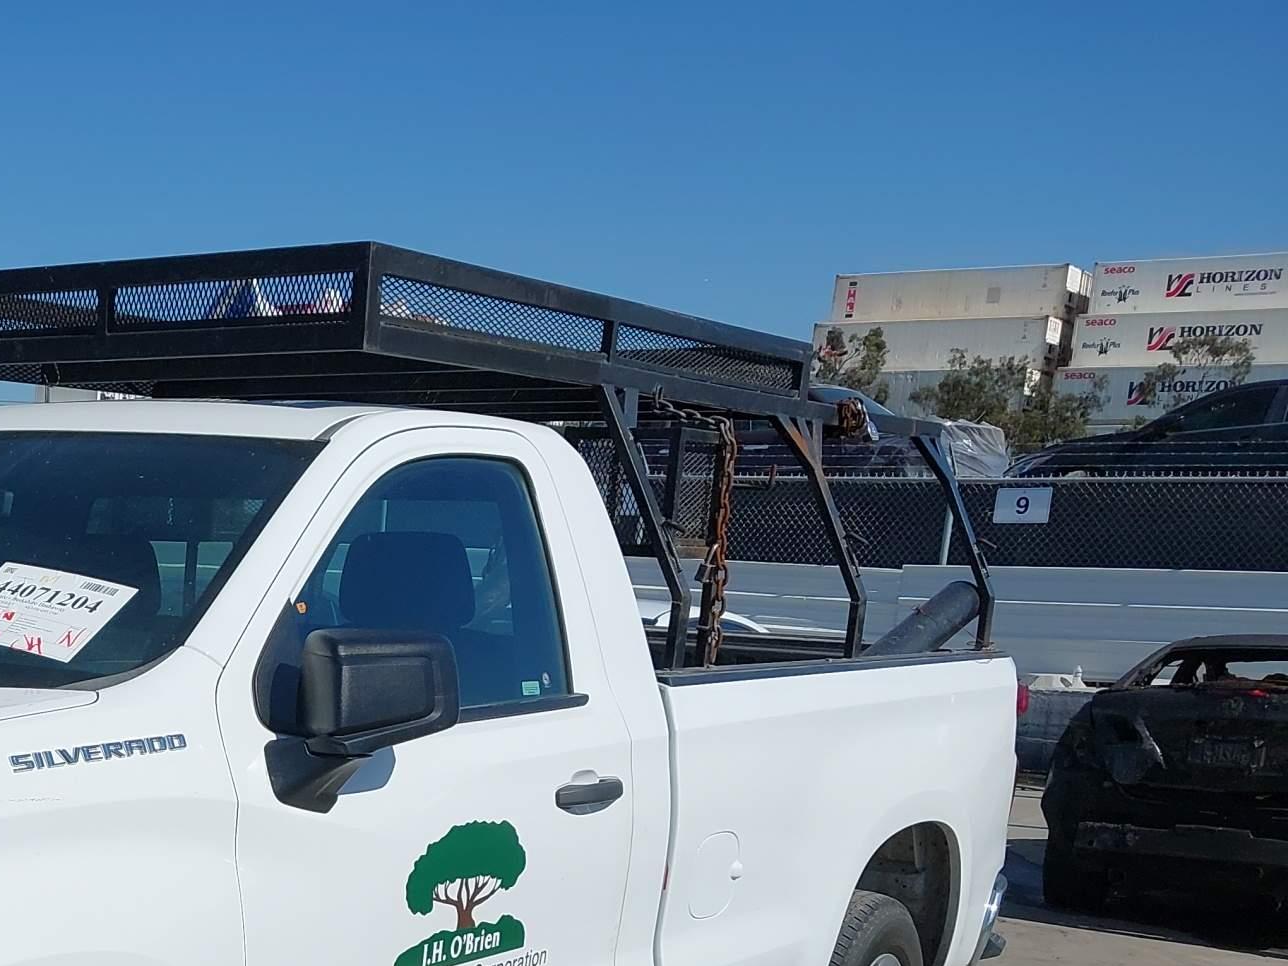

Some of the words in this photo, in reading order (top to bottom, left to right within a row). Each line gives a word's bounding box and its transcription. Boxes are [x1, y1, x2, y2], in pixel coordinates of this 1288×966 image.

[1103, 265, 1136, 275] seaco
[1198, 268, 1284, 284] HORIZON
[1196, 283, 1267, 294] LINES
[1085, 317, 1117, 326] seaco
[1179, 323, 1263, 338] HORIZON
[1064, 371, 1096, 380] seaco
[1016, 496, 1030, 515] 9
[8, 733, 187, 773] SILVERADO
[450, 929, 501, 958] O'Brien
